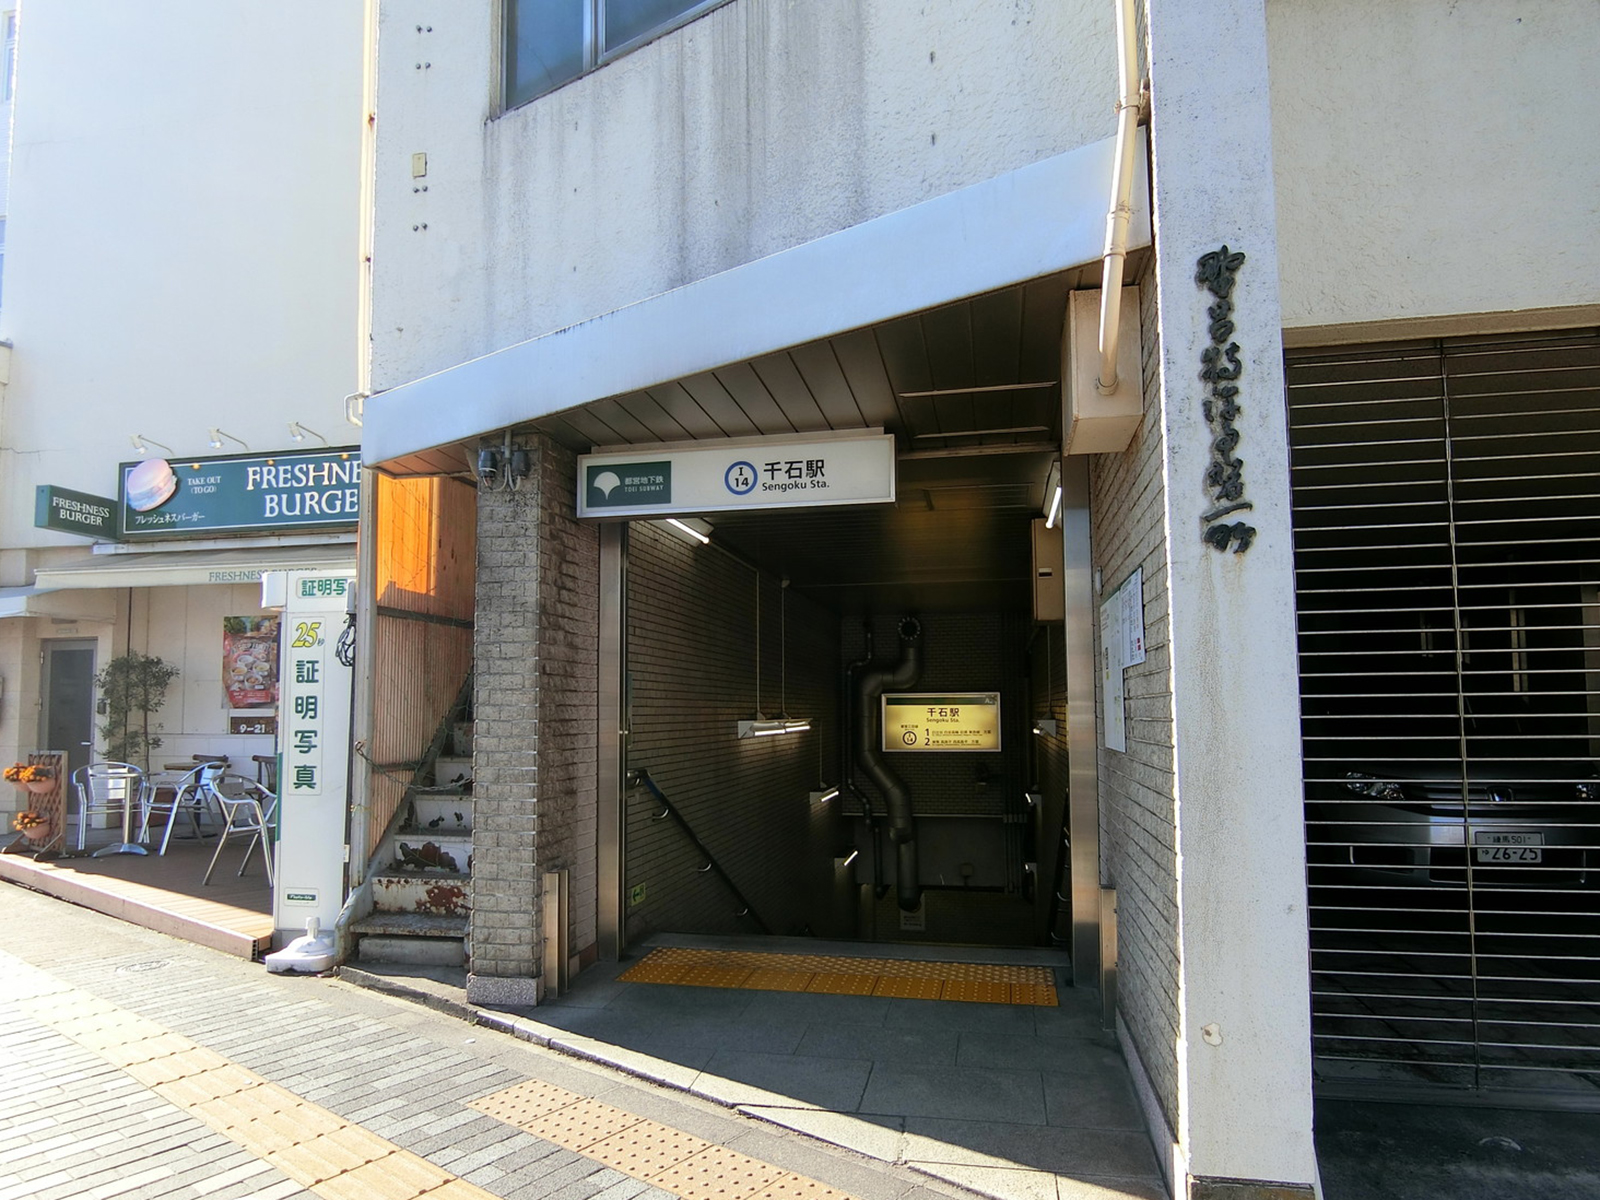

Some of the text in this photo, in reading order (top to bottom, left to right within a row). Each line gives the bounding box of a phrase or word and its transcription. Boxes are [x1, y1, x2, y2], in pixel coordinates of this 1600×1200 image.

[738, 467, 744, 476] I
[763, 459, 826, 480] 千石駅
[188, 476, 222, 486] TAKE OUT
[624, 475, 664, 485] 都営地下鉄
[734, 476, 750, 488] 14
[761, 479, 830, 494] Sengoku Sta.
[191, 485, 217, 494] (TO GO)
[53, 496, 110, 518] FRESHNESS
[264, 489, 359, 517] BURGE
[60, 508, 103, 527] BURGER
[134, 511, 205, 525] フレッシュネスバーガー
[301, 578, 348, 597] 証明写
[926, 707, 960, 717] 千石駅
[293, 659, 320, 790] 証明写真
[925, 728, 930, 736] 1
[924, 738, 931, 746] 2
